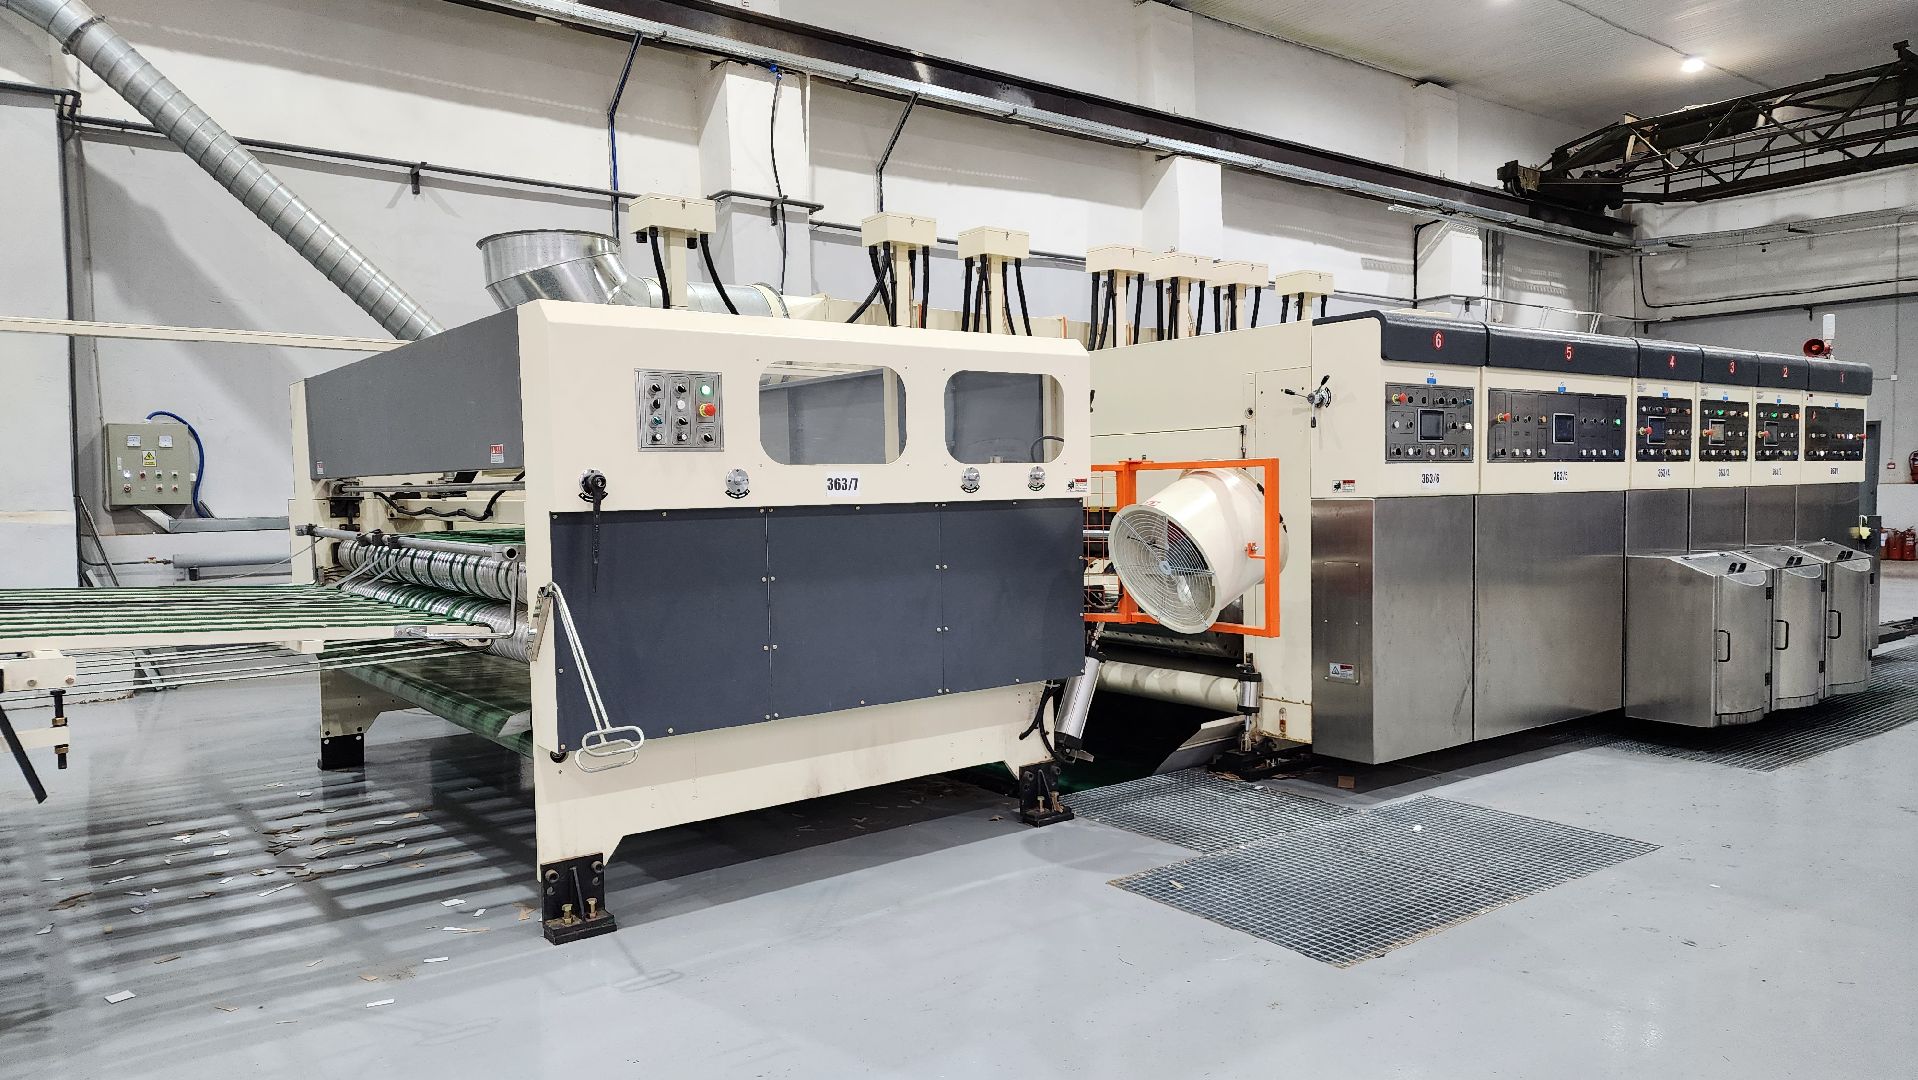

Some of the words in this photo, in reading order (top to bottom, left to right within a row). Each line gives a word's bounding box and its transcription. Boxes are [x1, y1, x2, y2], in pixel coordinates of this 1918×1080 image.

[1434, 332, 1442, 349] 6
[1565, 346, 1572, 360] 5
[1669, 355, 1675, 368] 4
[1729, 361, 1735, 373] 3
[1782, 366, 1788, 378] 2
[826, 477, 859, 491] 363/7
[1421, 473, 1440, 484] 363/6
